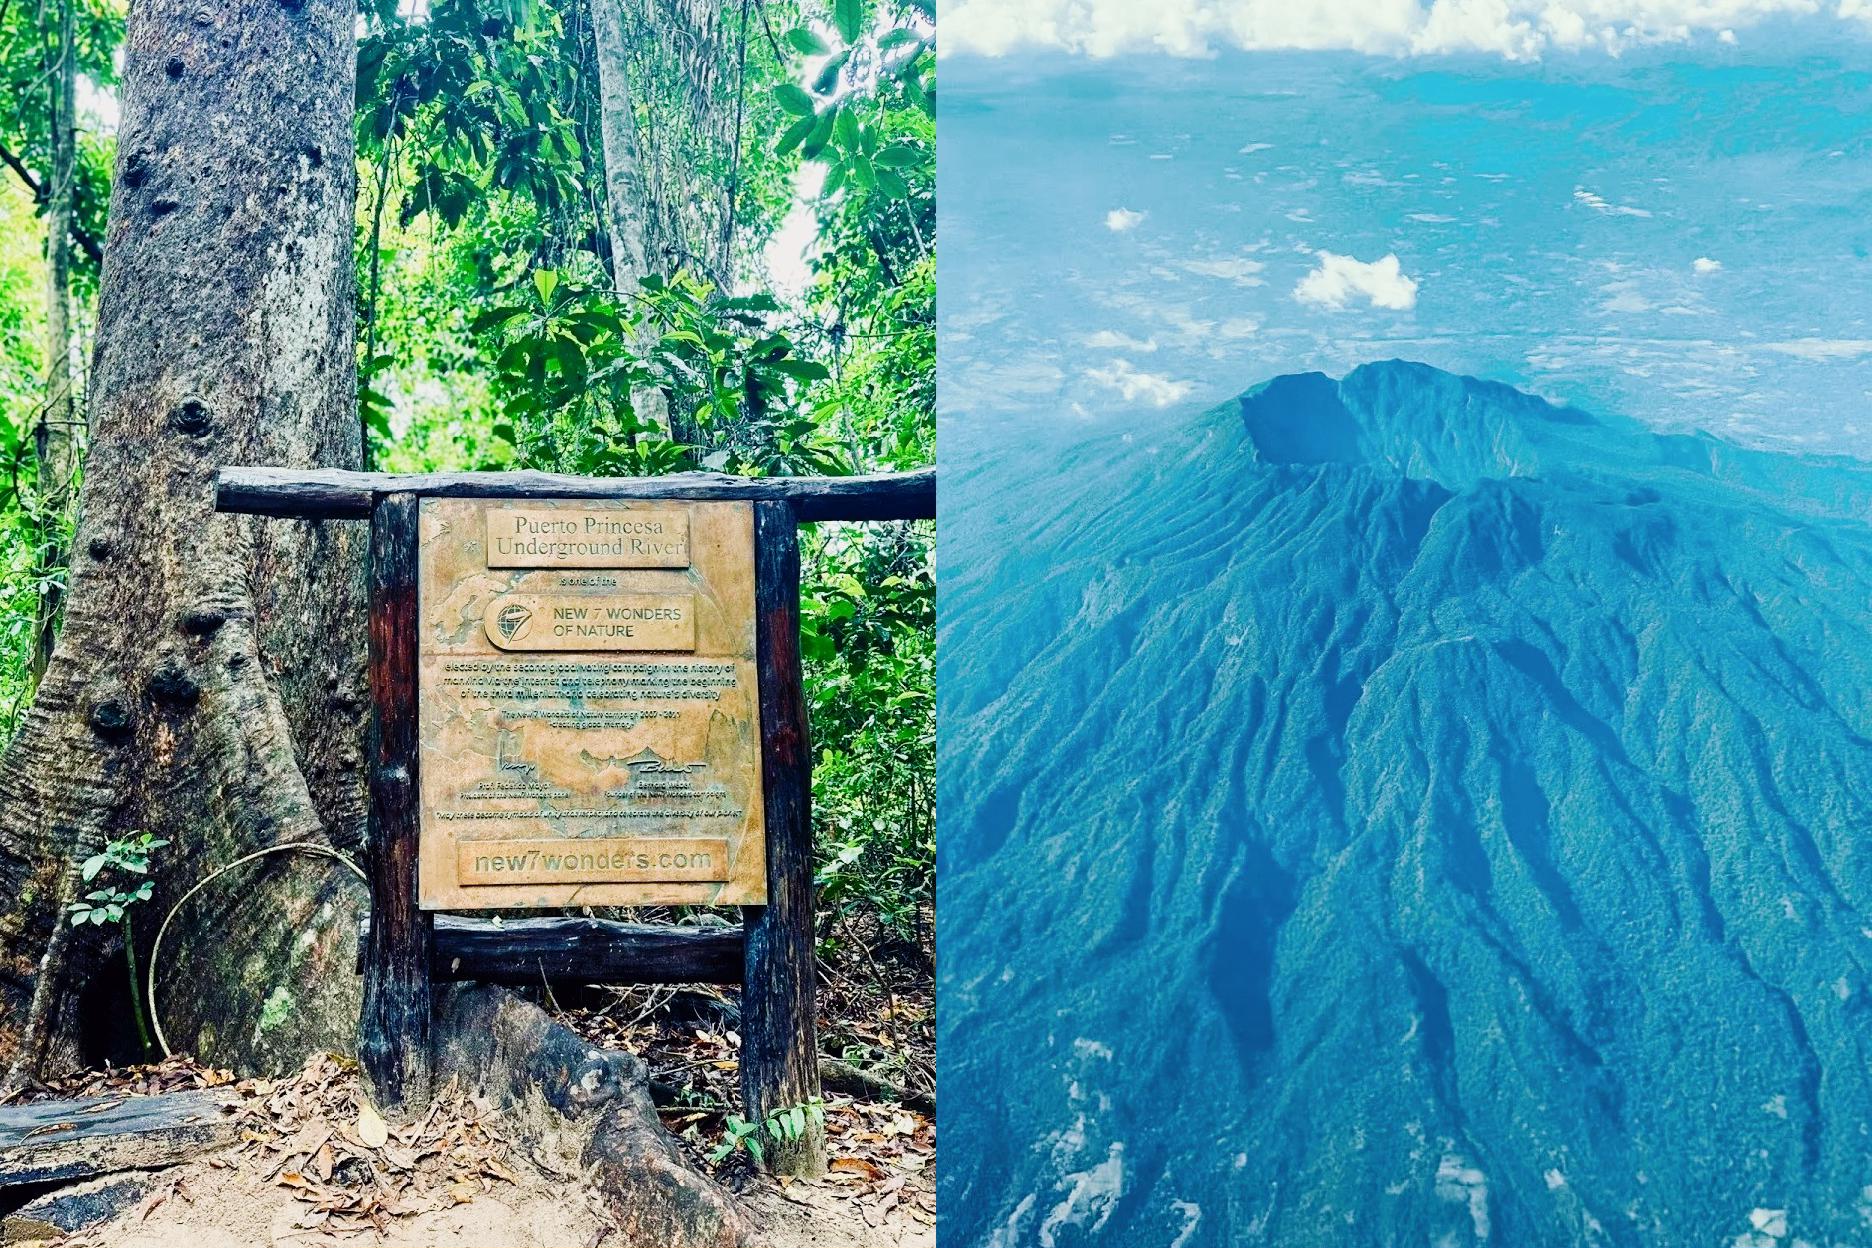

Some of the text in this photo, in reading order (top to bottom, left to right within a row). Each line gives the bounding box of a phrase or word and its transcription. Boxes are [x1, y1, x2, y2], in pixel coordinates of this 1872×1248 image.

[515, 516, 663, 535] Puerto Princesa
[496, 537, 684, 560] Underground River
[559, 576, 617, 587] is one of the
[553, 607, 682, 621] NEW 7 WONDERS
[553, 624, 634, 638] OF NATURE
[495, 663, 511, 673] the
[513, 663, 547, 673] second
[612, 664, 659, 676] campaign
[674, 664, 688, 673] the
[561, 677, 580, 687] and
[475, 849, 712, 873] new7wonders.com
